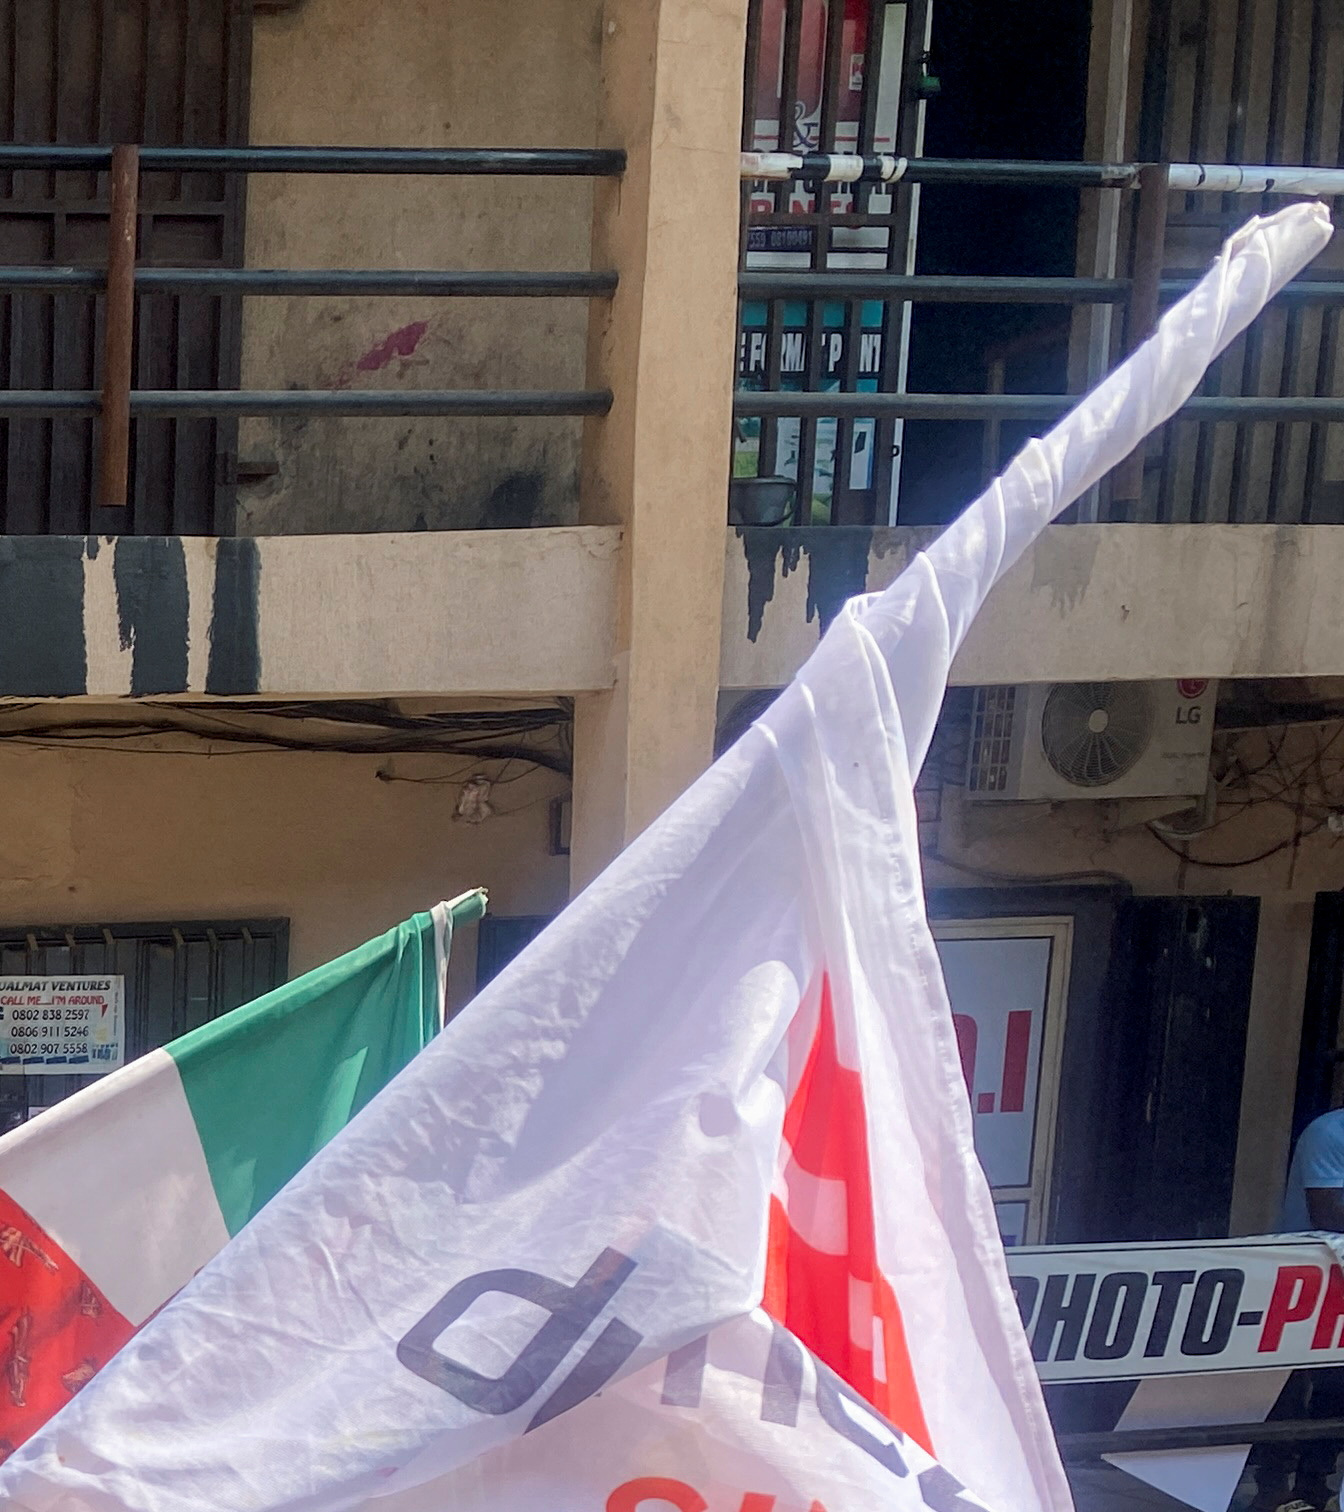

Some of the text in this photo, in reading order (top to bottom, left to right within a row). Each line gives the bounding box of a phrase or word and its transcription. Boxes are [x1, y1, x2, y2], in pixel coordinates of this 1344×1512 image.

[1176, 706, 1201, 724] LG
[50, 980, 111, 992] VENTURES
[0, 996, 25, 1006] CALL
[68, 995, 105, 1005] AROUND
[12, 1009, 90, 1020] 0802 838 2597
[11, 1026, 89, 1037] 0806 911 5246
[10, 1043, 88, 1055] 0802 907 5558
